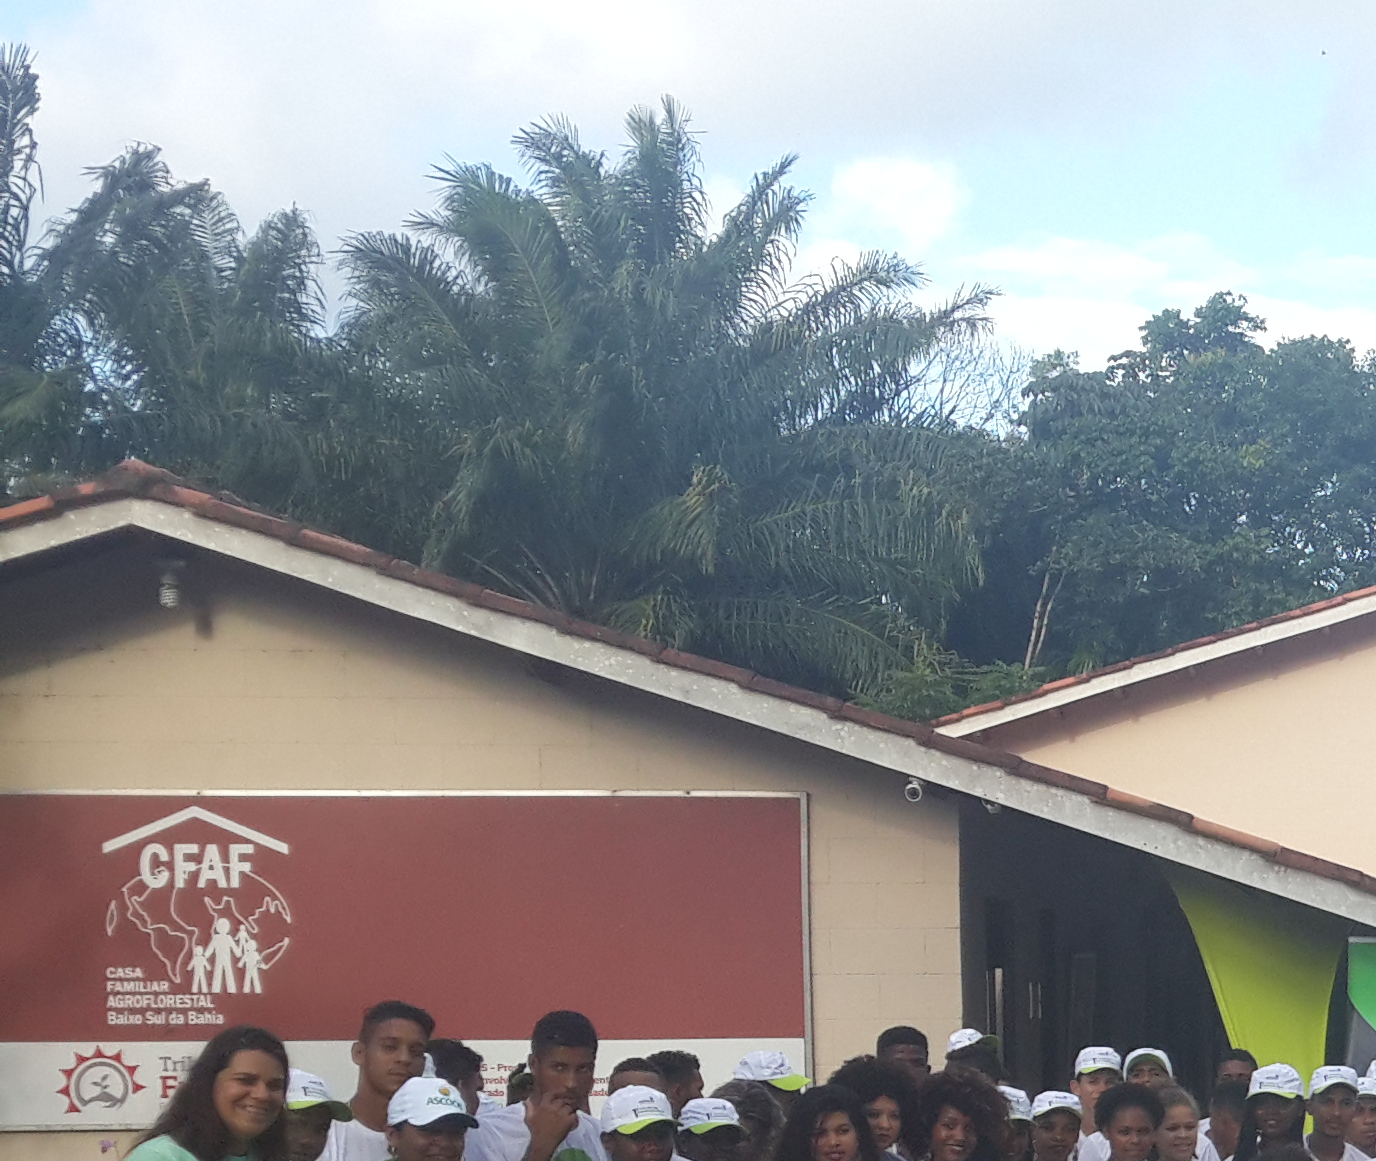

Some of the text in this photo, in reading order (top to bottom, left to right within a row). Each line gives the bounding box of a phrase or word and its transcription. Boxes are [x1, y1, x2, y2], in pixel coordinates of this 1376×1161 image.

[139, 842, 254, 889] CFAF
[106, 967, 143, 978] CASA
[106, 981, 169, 992] FAMILIAR
[106, 994, 215, 1008] AGROFLORESTAL
[107, 1011, 224, 1024] Baixo Sul da Bahia
